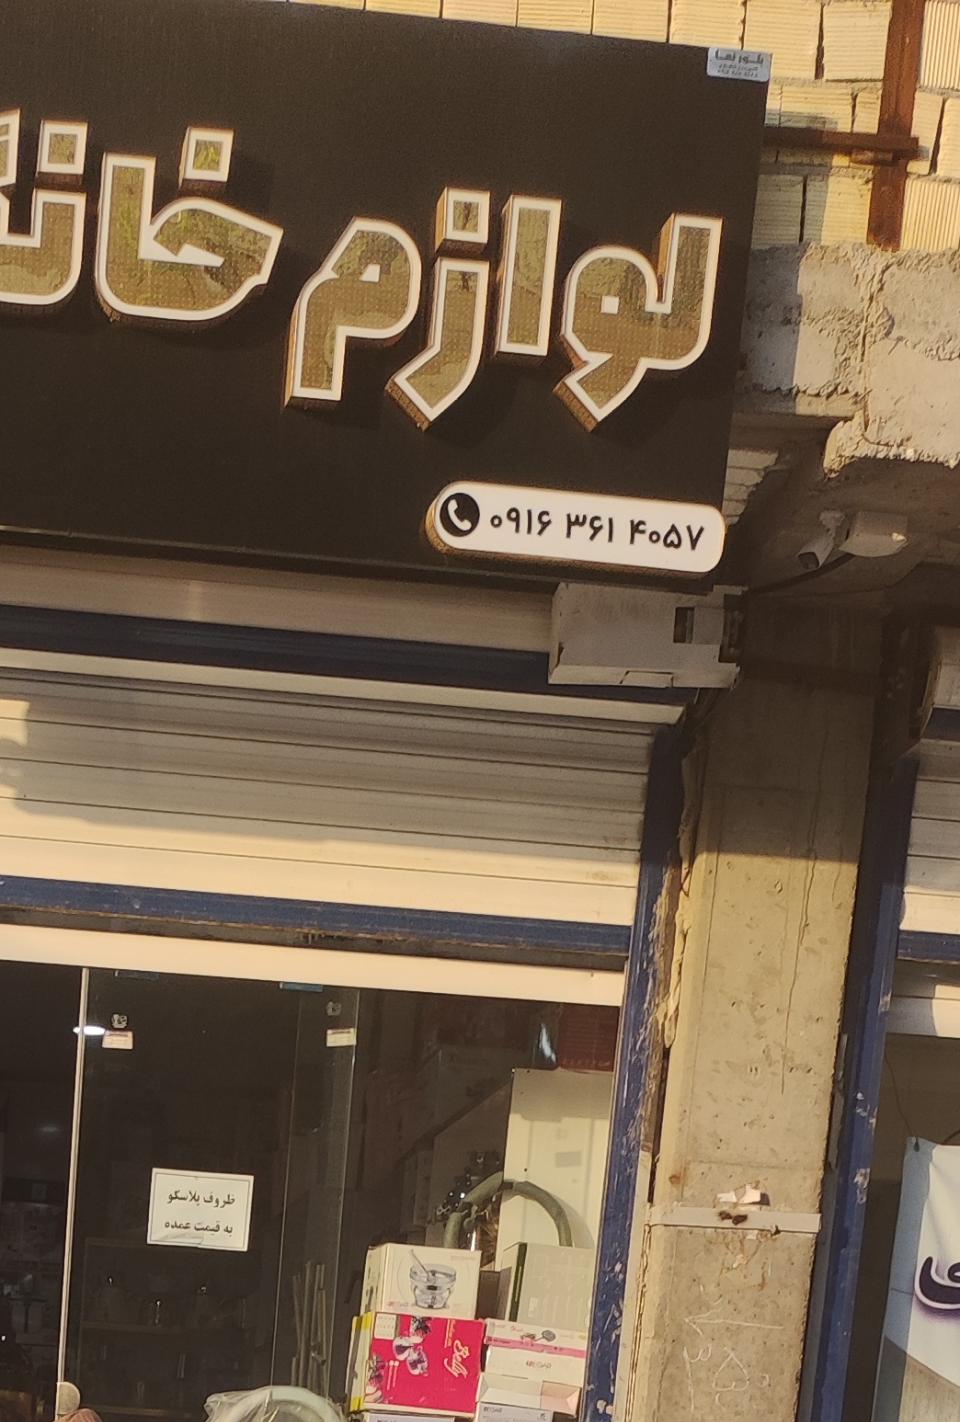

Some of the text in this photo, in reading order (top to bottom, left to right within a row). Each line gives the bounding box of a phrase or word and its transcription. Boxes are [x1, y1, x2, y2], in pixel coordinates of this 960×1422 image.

[289, 186, 724, 424] لوازم
[203, 1191, 236, 1208] ظروف
[164, 1220, 234, 1237] به قیمت عمده
